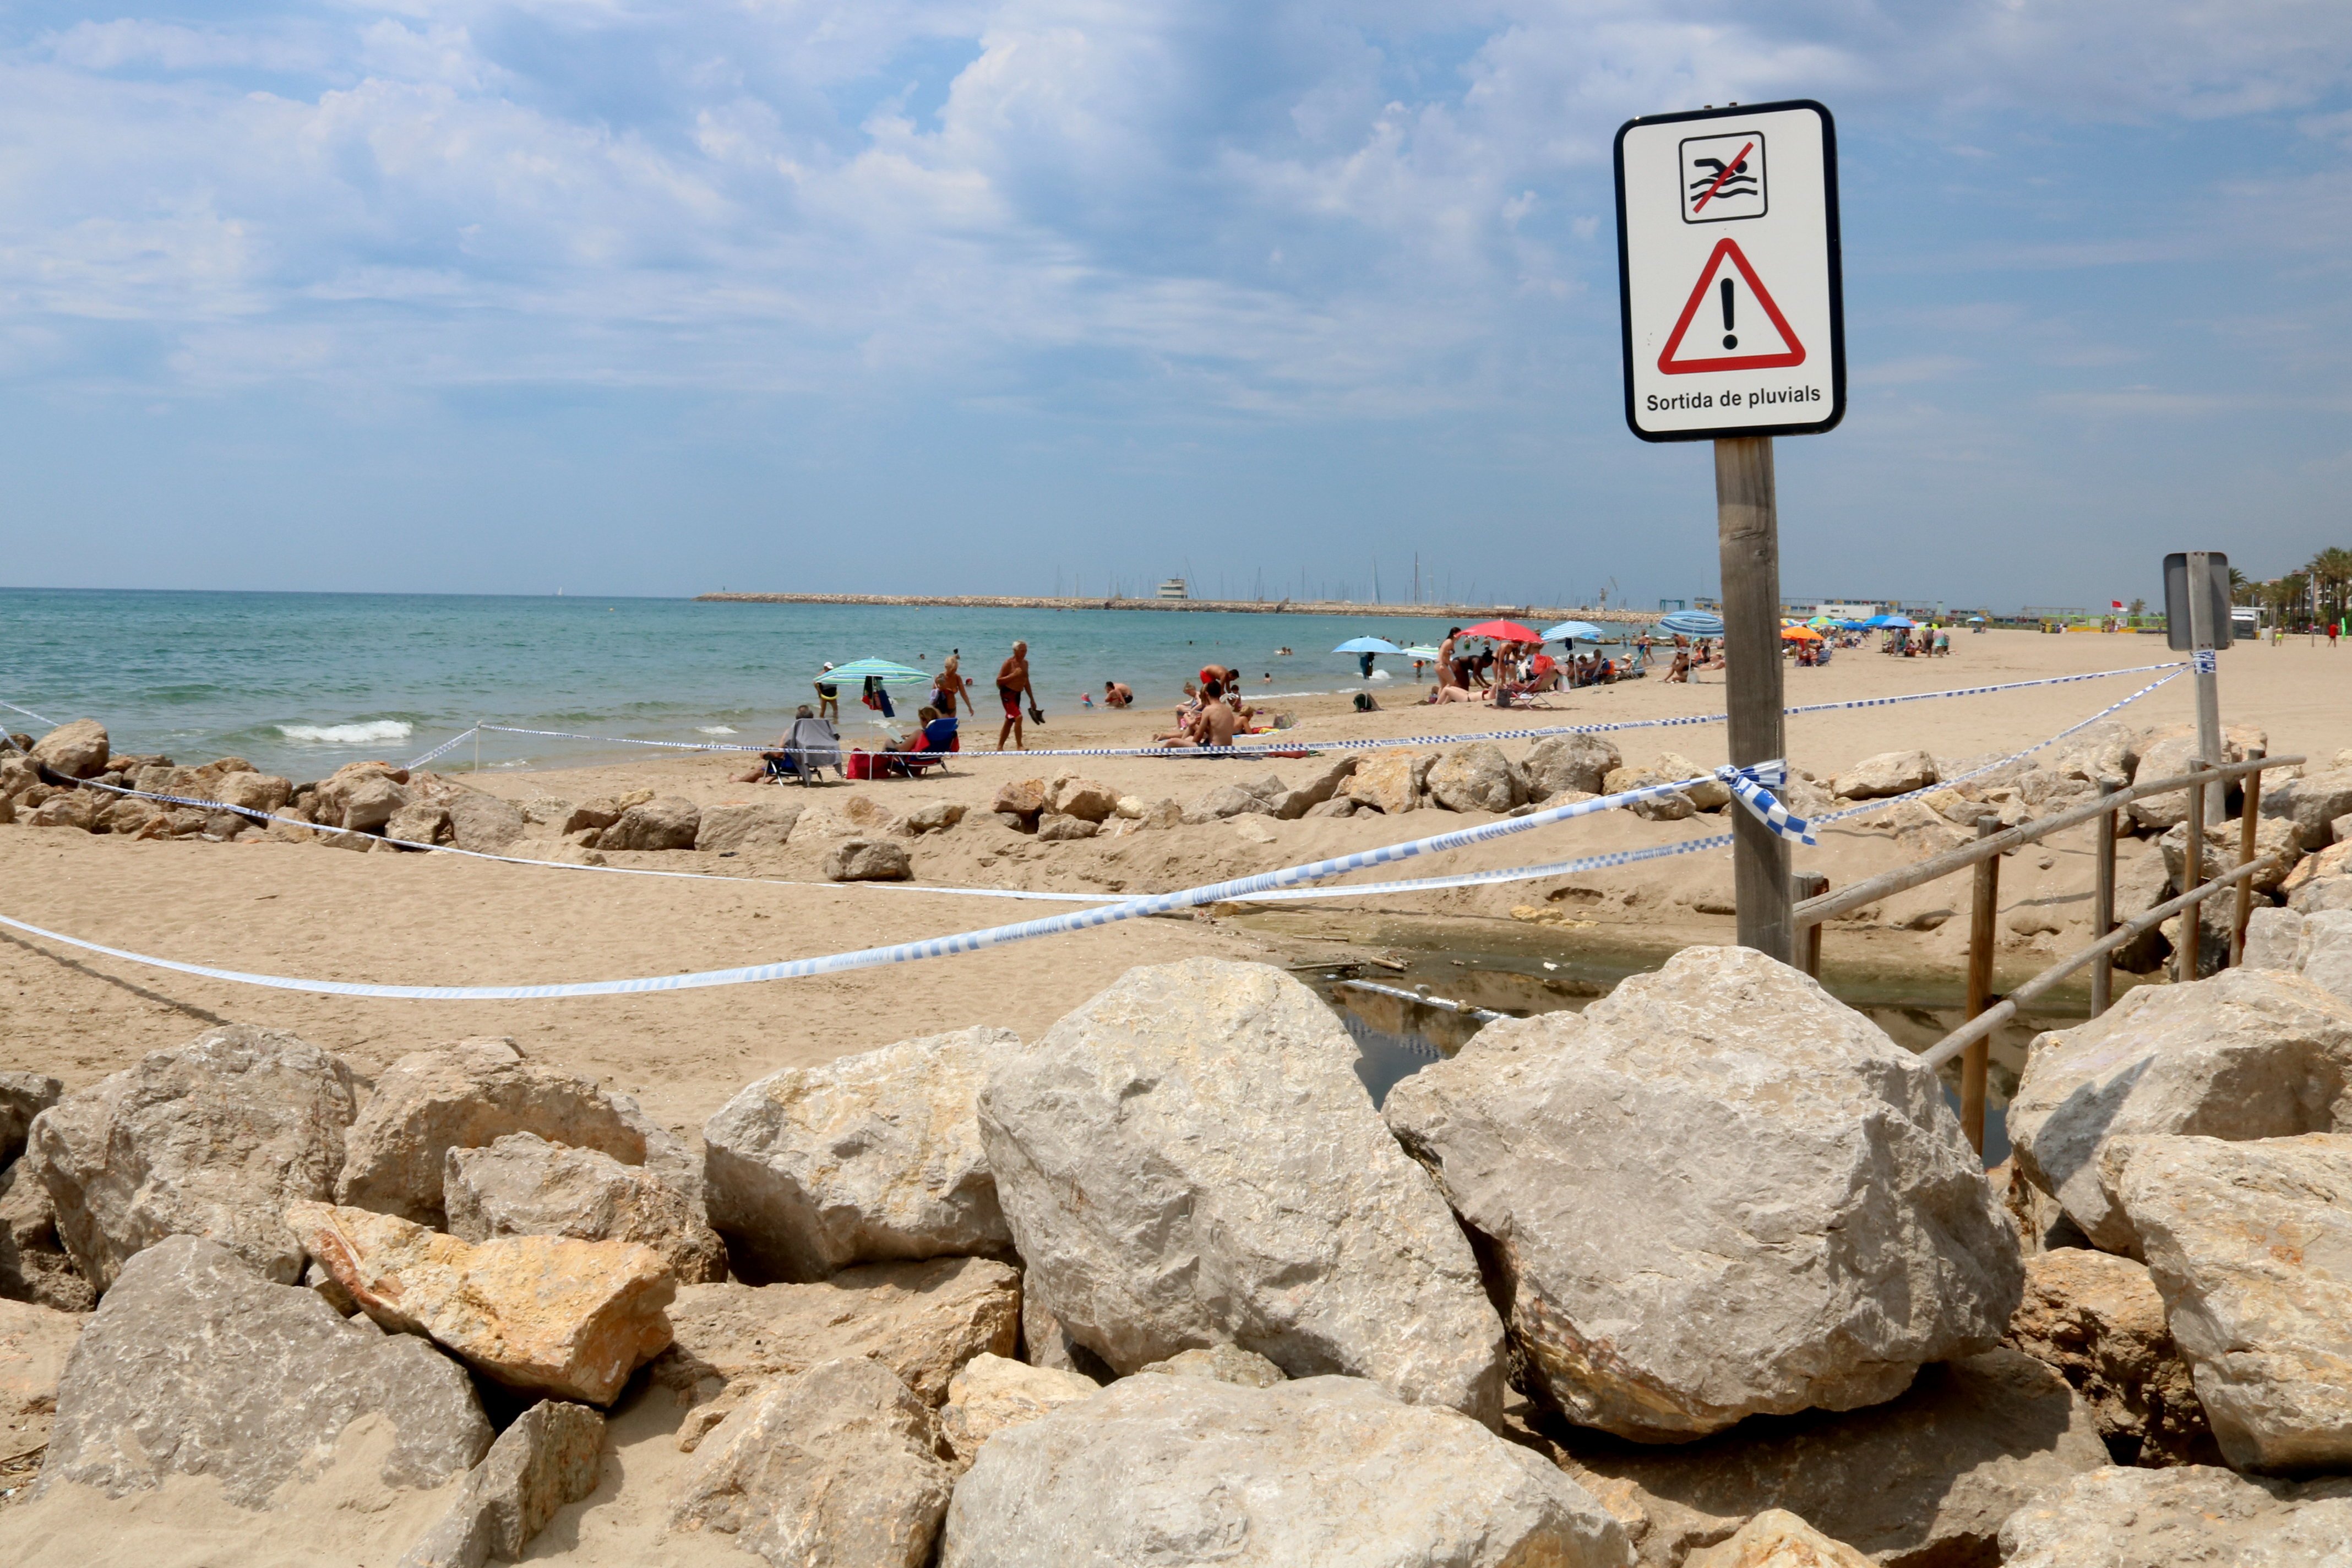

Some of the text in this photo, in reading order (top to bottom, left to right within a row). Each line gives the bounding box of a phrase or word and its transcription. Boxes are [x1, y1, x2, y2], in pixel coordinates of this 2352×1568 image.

[1647, 385, 1821, 411] Sortida de pluvials
